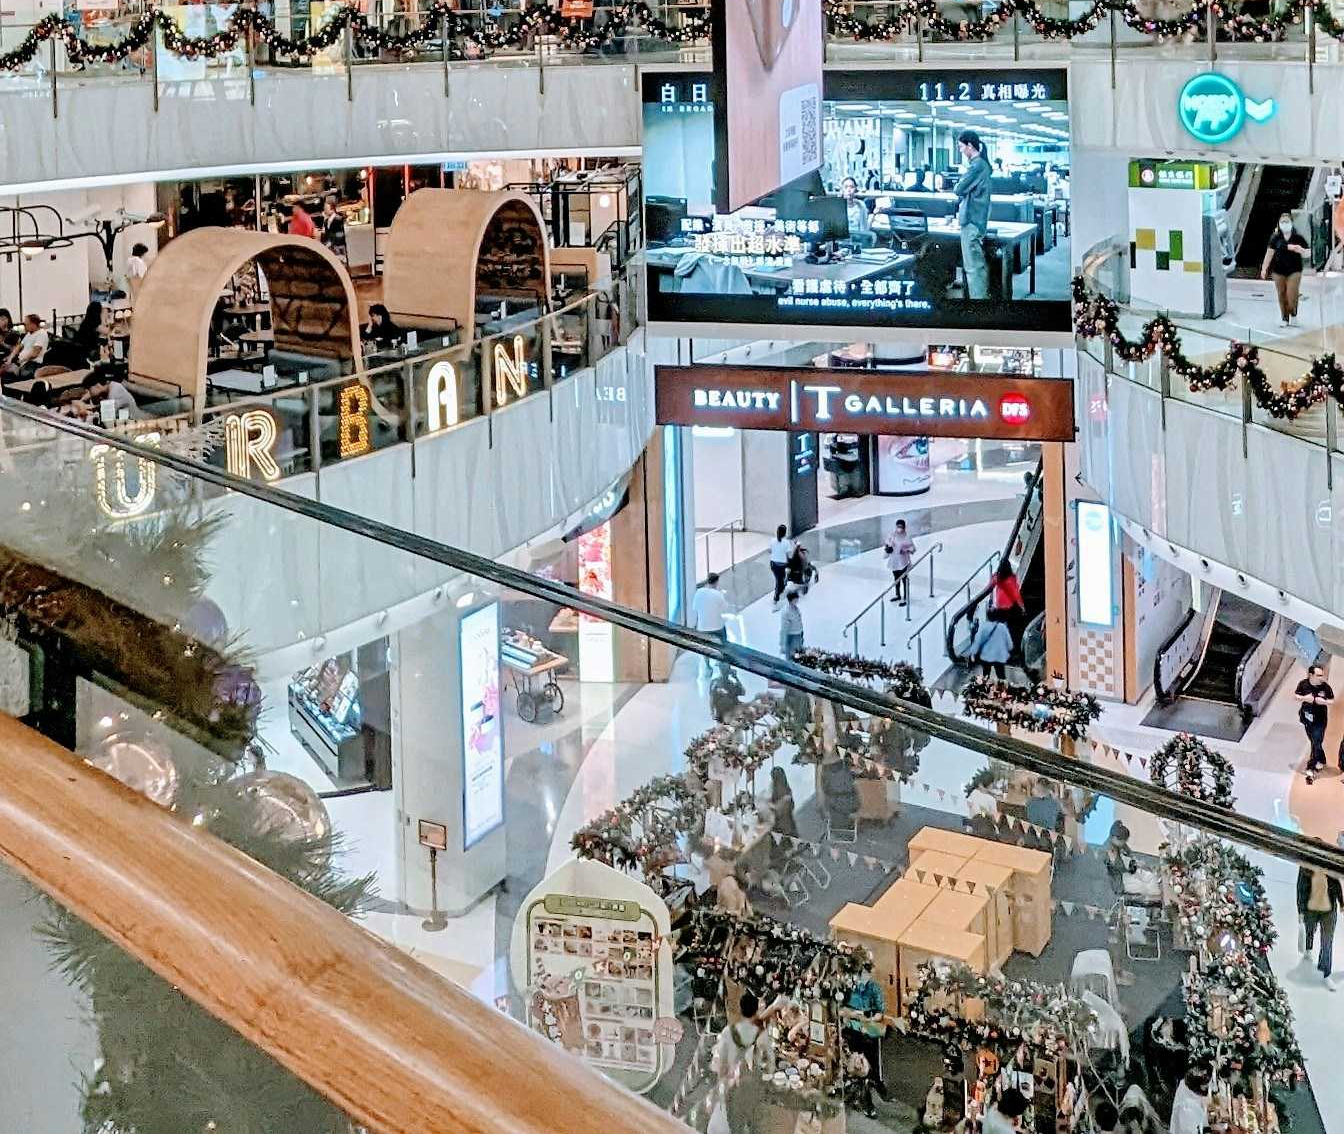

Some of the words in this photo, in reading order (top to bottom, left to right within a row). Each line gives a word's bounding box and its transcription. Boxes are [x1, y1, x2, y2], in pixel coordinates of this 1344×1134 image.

[919, 82, 971, 101] 11.2
[777, 297, 794, 306] evil
[795, 298, 819, 306] nurse
[693, 389, 781, 411] BEAUTY
[803, 385, 841, 419] T
[844, 396, 989, 417] GALLERIA
[1001, 402, 1030, 417] DFS
